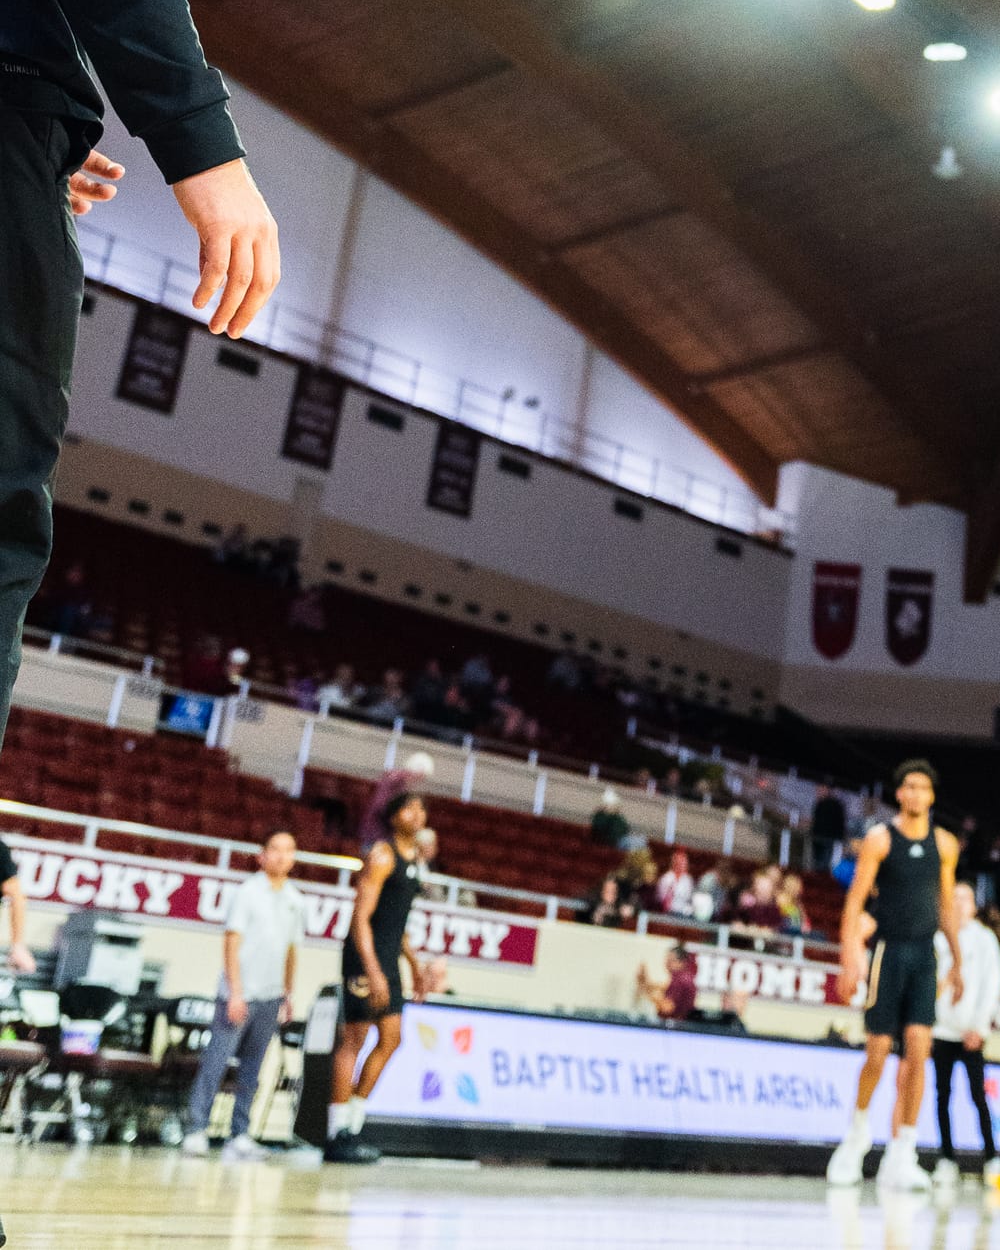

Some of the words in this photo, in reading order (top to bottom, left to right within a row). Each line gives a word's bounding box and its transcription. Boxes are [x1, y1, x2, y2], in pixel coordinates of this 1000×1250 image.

[695, 955, 827, 1002] HOME
[490, 1048, 621, 1096] BAPTIST
[630, 1061, 747, 1104] HEALTH
[752, 1072, 844, 1110] ARENA
